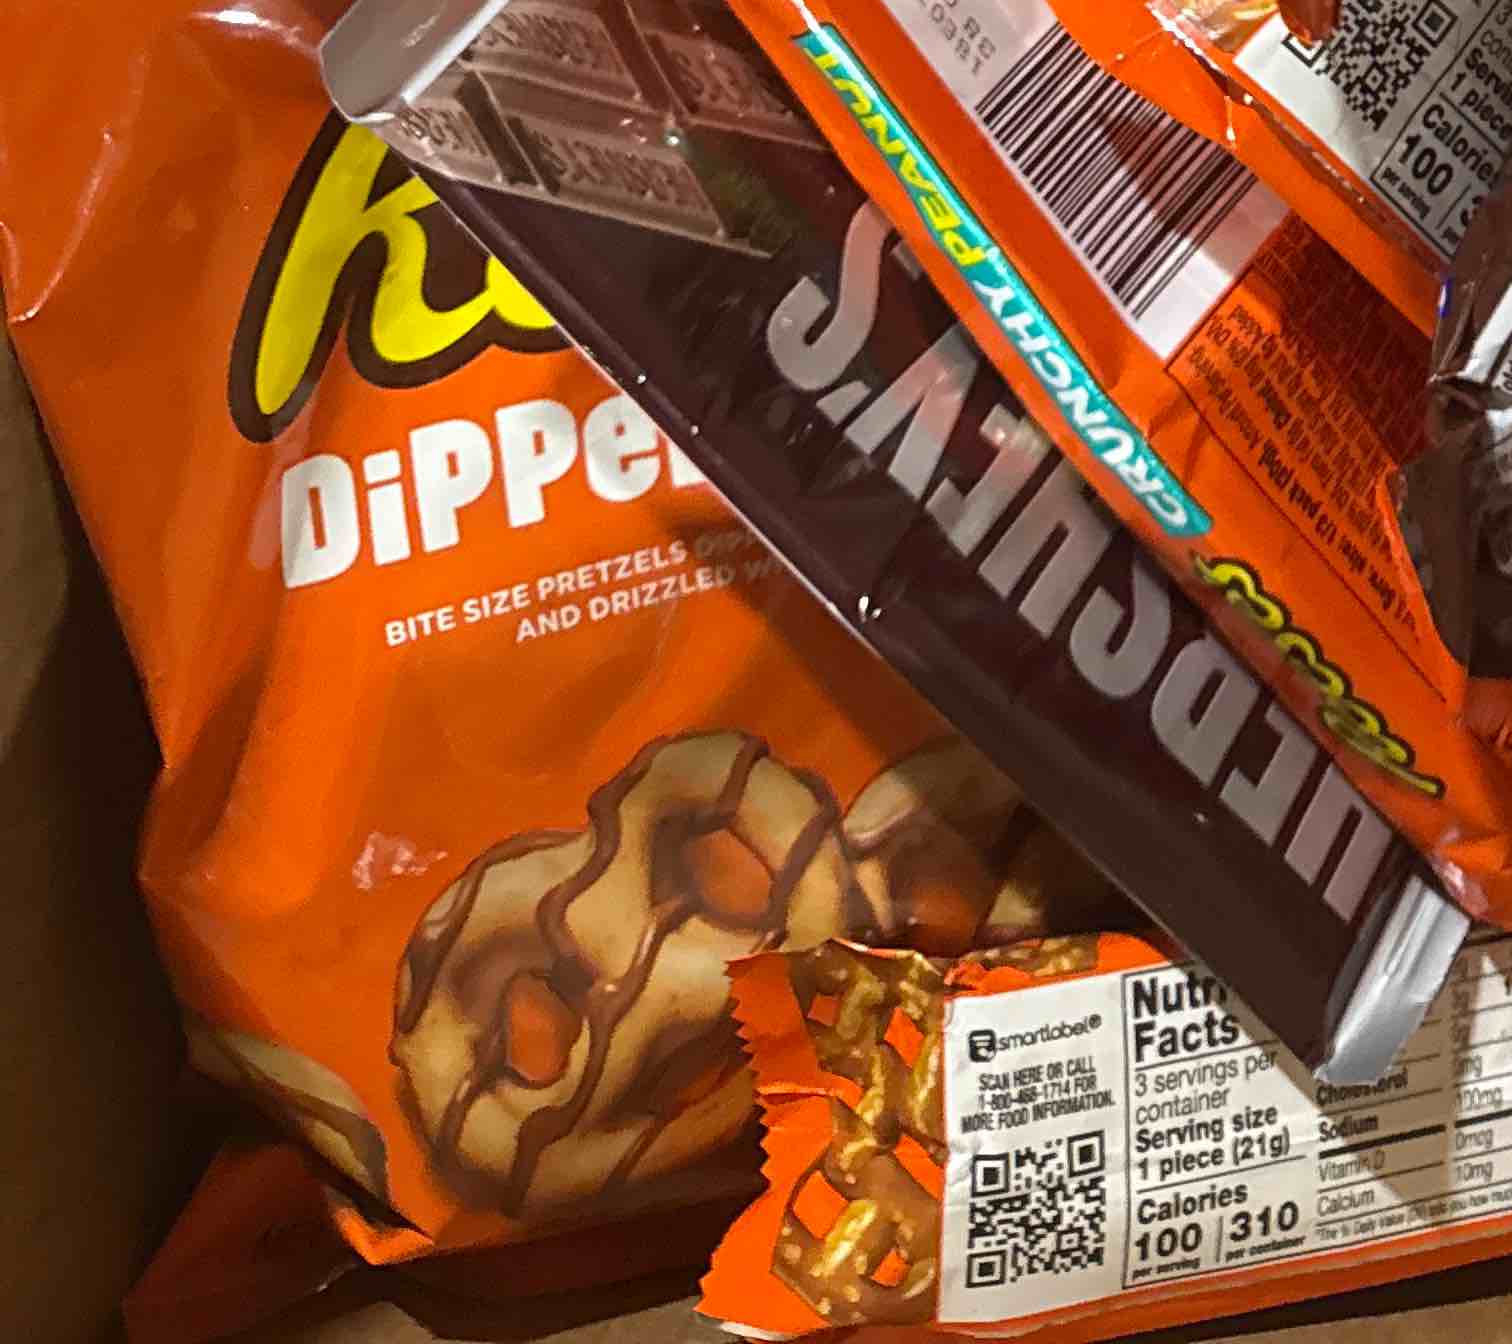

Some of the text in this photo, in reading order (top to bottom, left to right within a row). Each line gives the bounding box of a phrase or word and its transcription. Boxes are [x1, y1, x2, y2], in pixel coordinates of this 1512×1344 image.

[1388, 130, 1459, 199] 100
[1415, 100, 1507, 186] Calorie
[975, 262, 1180, 530] CRUNCHY
[384, 542, 688, 647] BITE SIZE PRETZELS
[516, 562, 736, 643] AND DRIZZLED
[1130, 1008, 1242, 1063] Facts
[977, 1055, 1096, 1091] SCAN HERE OR CALL
[1073, 1075, 1097, 1093] FOR
[1132, 1047, 1278, 1097] 3 servings per
[960, 1110, 996, 1133] MORE
[997, 1106, 1030, 1128] FOOD
[1133, 1086, 1232, 1125] container
[1133, 1103, 1280, 1152] Serving size
[1316, 1111, 1380, 1142] Sodium
[1158, 1144, 1229, 1181] piece
[1230, 1128, 1294, 1166] (21g)
[1137, 1181, 1250, 1225] Calories
[1316, 1189, 1377, 1218] Calcium
[1133, 1200, 1302, 1261] 100 310
